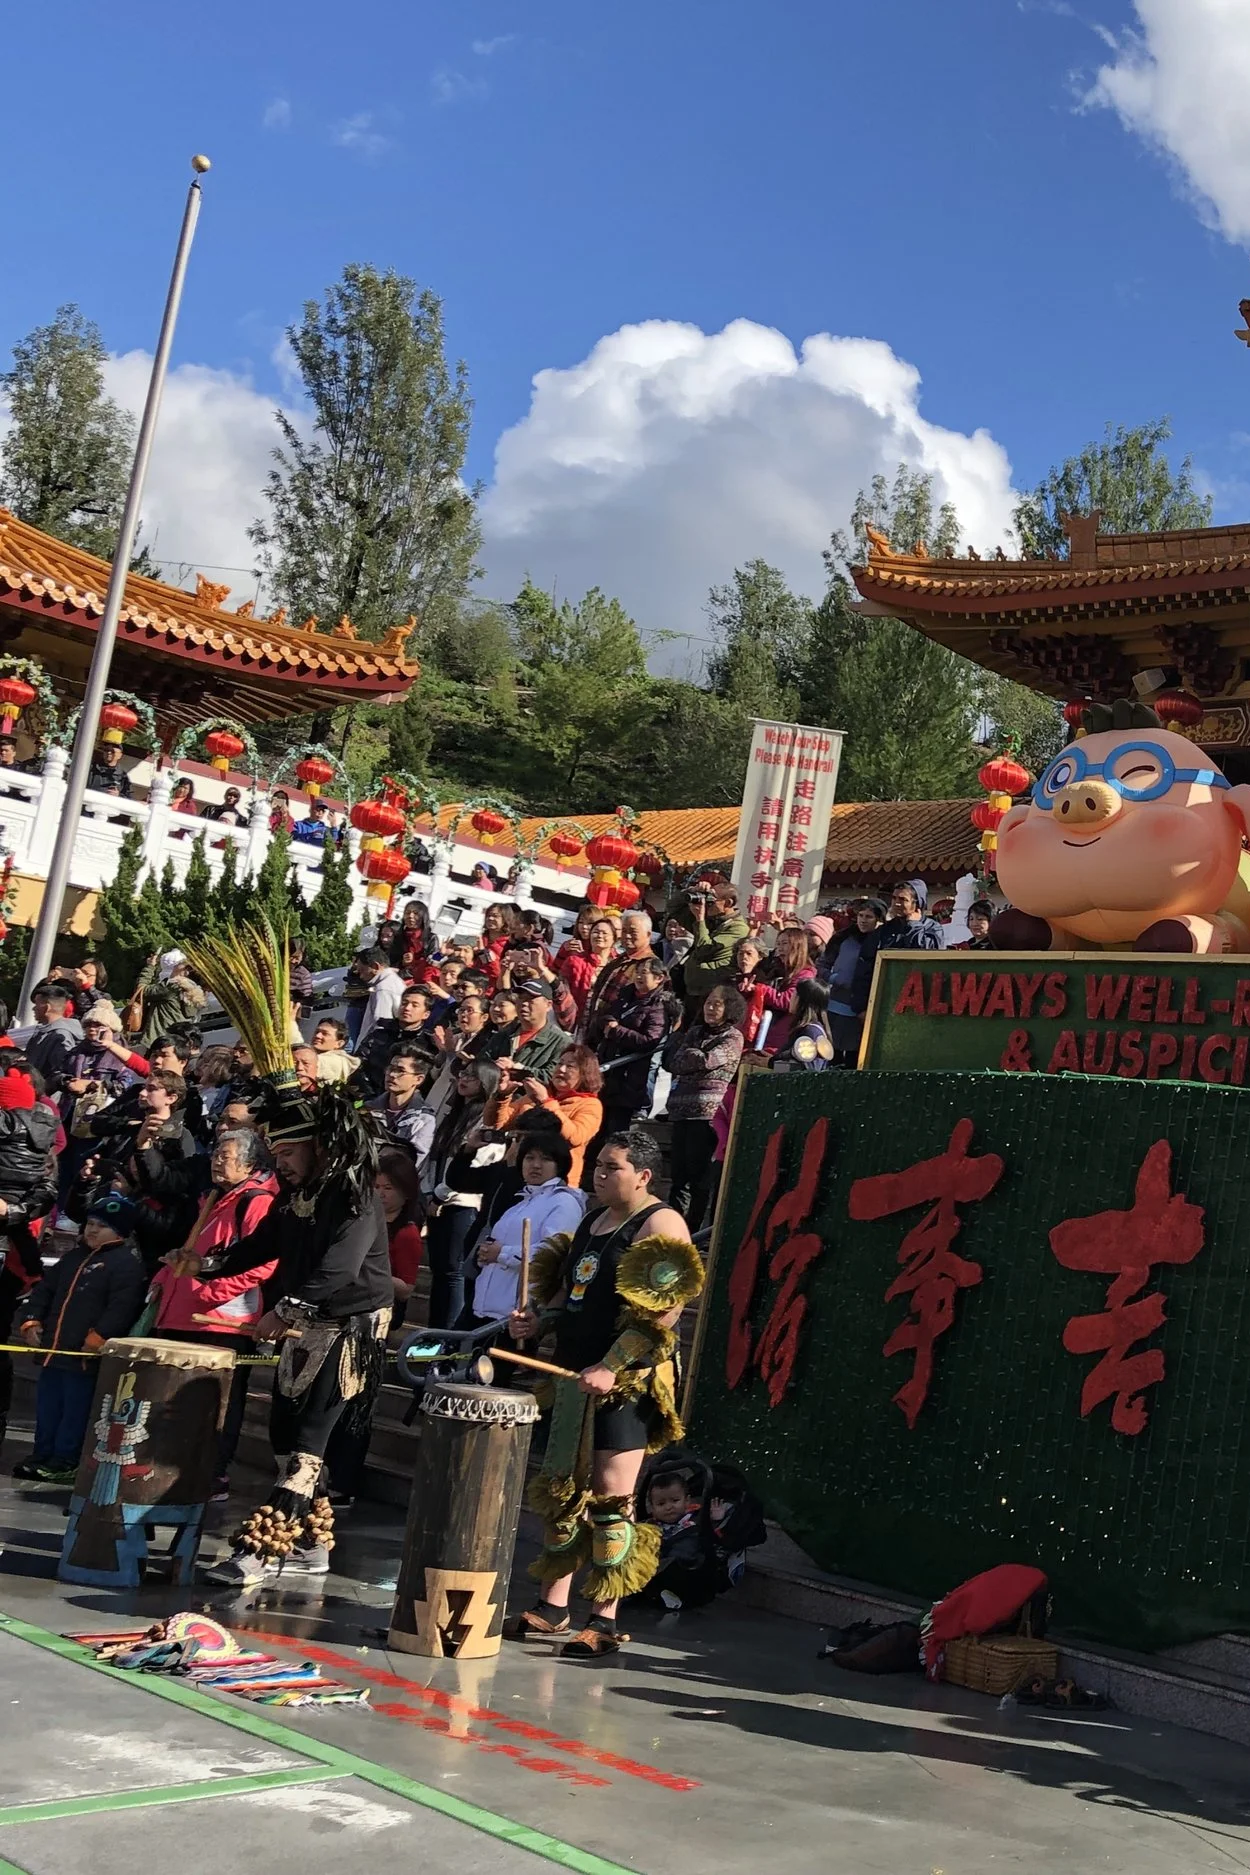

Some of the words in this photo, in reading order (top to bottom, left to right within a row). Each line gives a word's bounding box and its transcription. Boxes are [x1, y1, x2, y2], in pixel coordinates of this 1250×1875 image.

[764, 727, 793, 746] Watch
[793, 732, 811, 750] our
[812, 735, 831, 755] Step
[754, 747, 781, 765] Please
[797, 754, 834, 773] Handrail
[894, 969, 1068, 1019] ALWAYS
[1000, 1028, 1033, 1073] &
